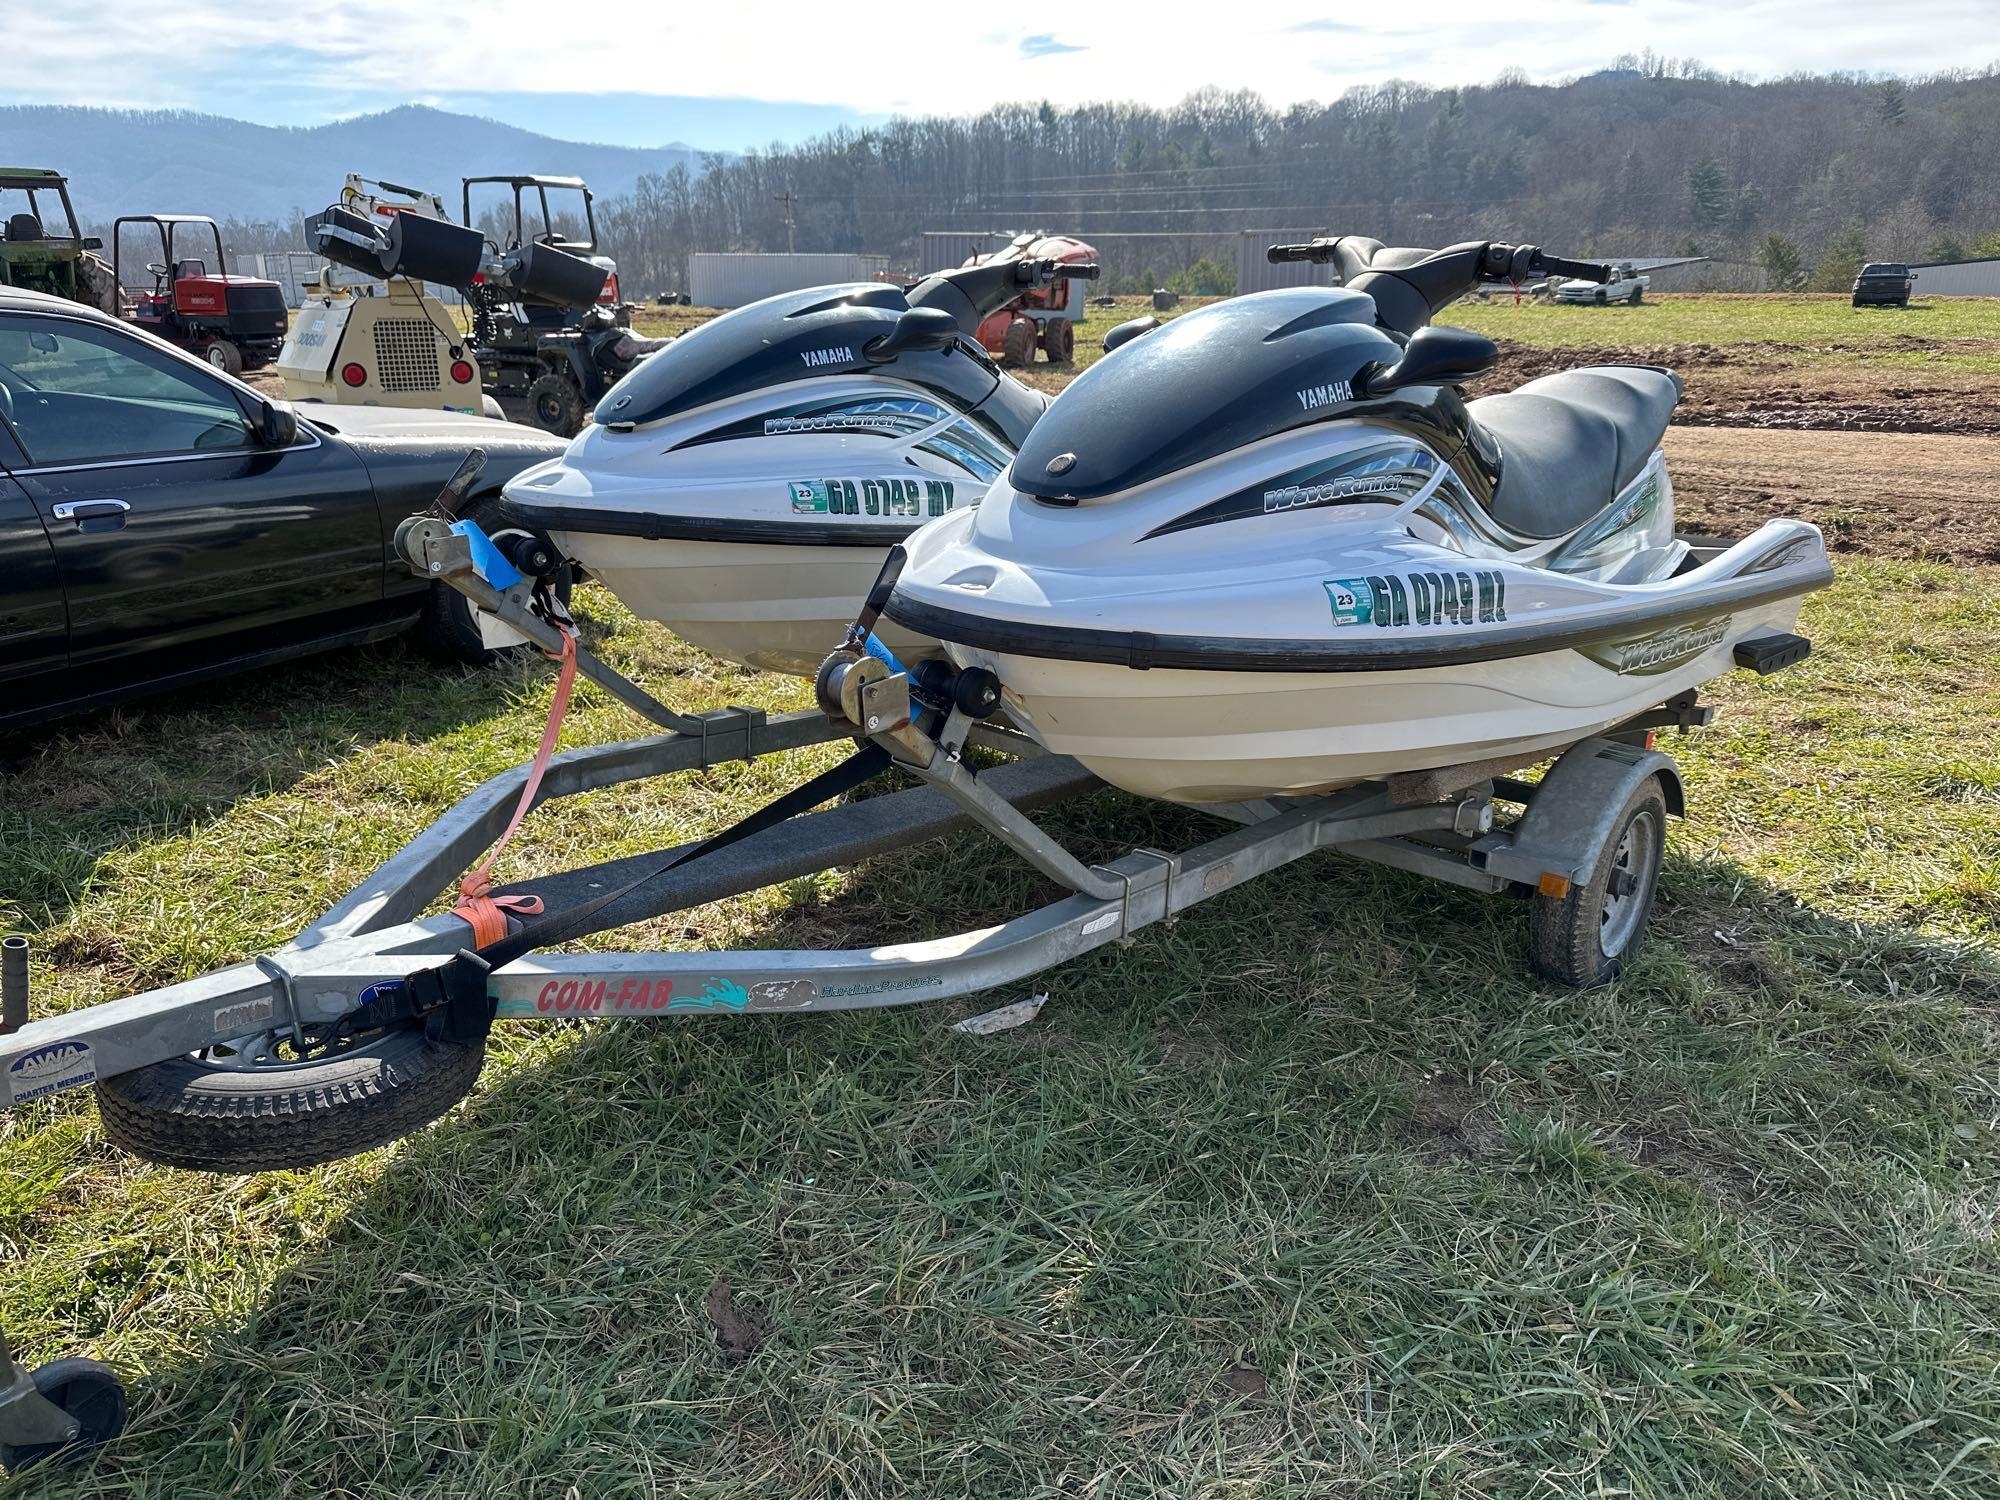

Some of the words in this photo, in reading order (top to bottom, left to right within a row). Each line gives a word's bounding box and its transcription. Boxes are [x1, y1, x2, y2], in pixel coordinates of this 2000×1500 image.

[801, 346, 854, 367] YAMAHA
[1297, 380, 1354, 410] YAMAHA
[765, 412, 897, 435] WaveRunner
[798, 489, 811, 498] 23
[825, 479, 859, 515] GA
[861, 479, 919, 516] 0749
[1264, 475, 1402, 513] WaveRunner
[1337, 594, 1353, 605] 23
[1366, 575, 1410, 627] GA
[1408, 571, 1473, 625] 0749
[537, 977, 673, 1012] COM-FAB
[22, 1045, 80, 1072] AWA
[14, 1083, 55, 1102] CHARTER
[57, 1071, 95, 1089] MEMBER
